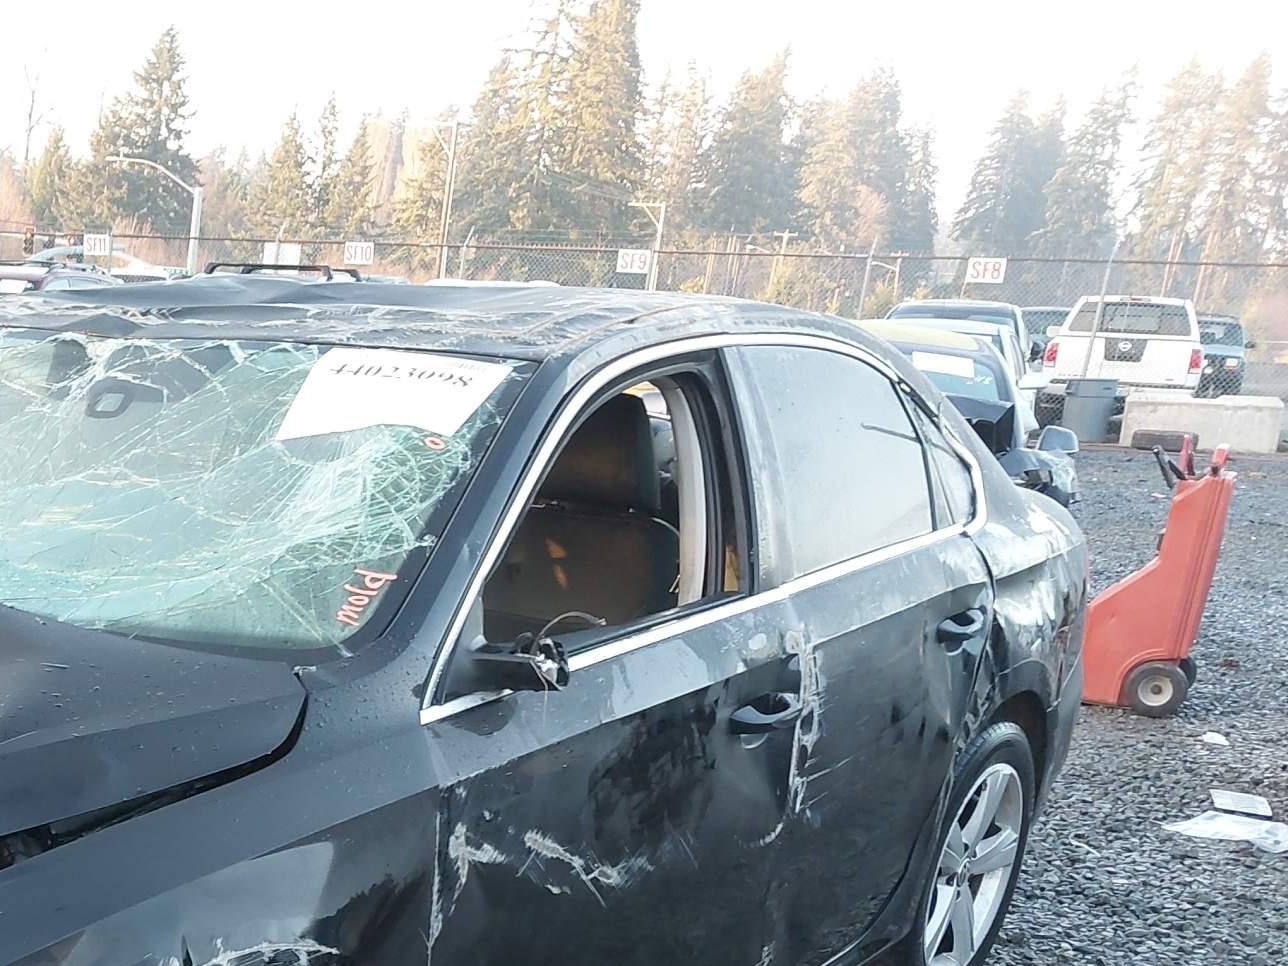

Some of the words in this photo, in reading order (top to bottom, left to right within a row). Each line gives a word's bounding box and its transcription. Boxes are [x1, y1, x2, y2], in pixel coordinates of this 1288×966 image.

[86, 237, 107, 252] SF11
[346, 244, 372, 261] SF10
[621, 252, 648, 270] SF9
[971, 260, 1002, 280] SF8
[329, 362, 473, 387] 44023098
[336, 567, 398, 627] mold
